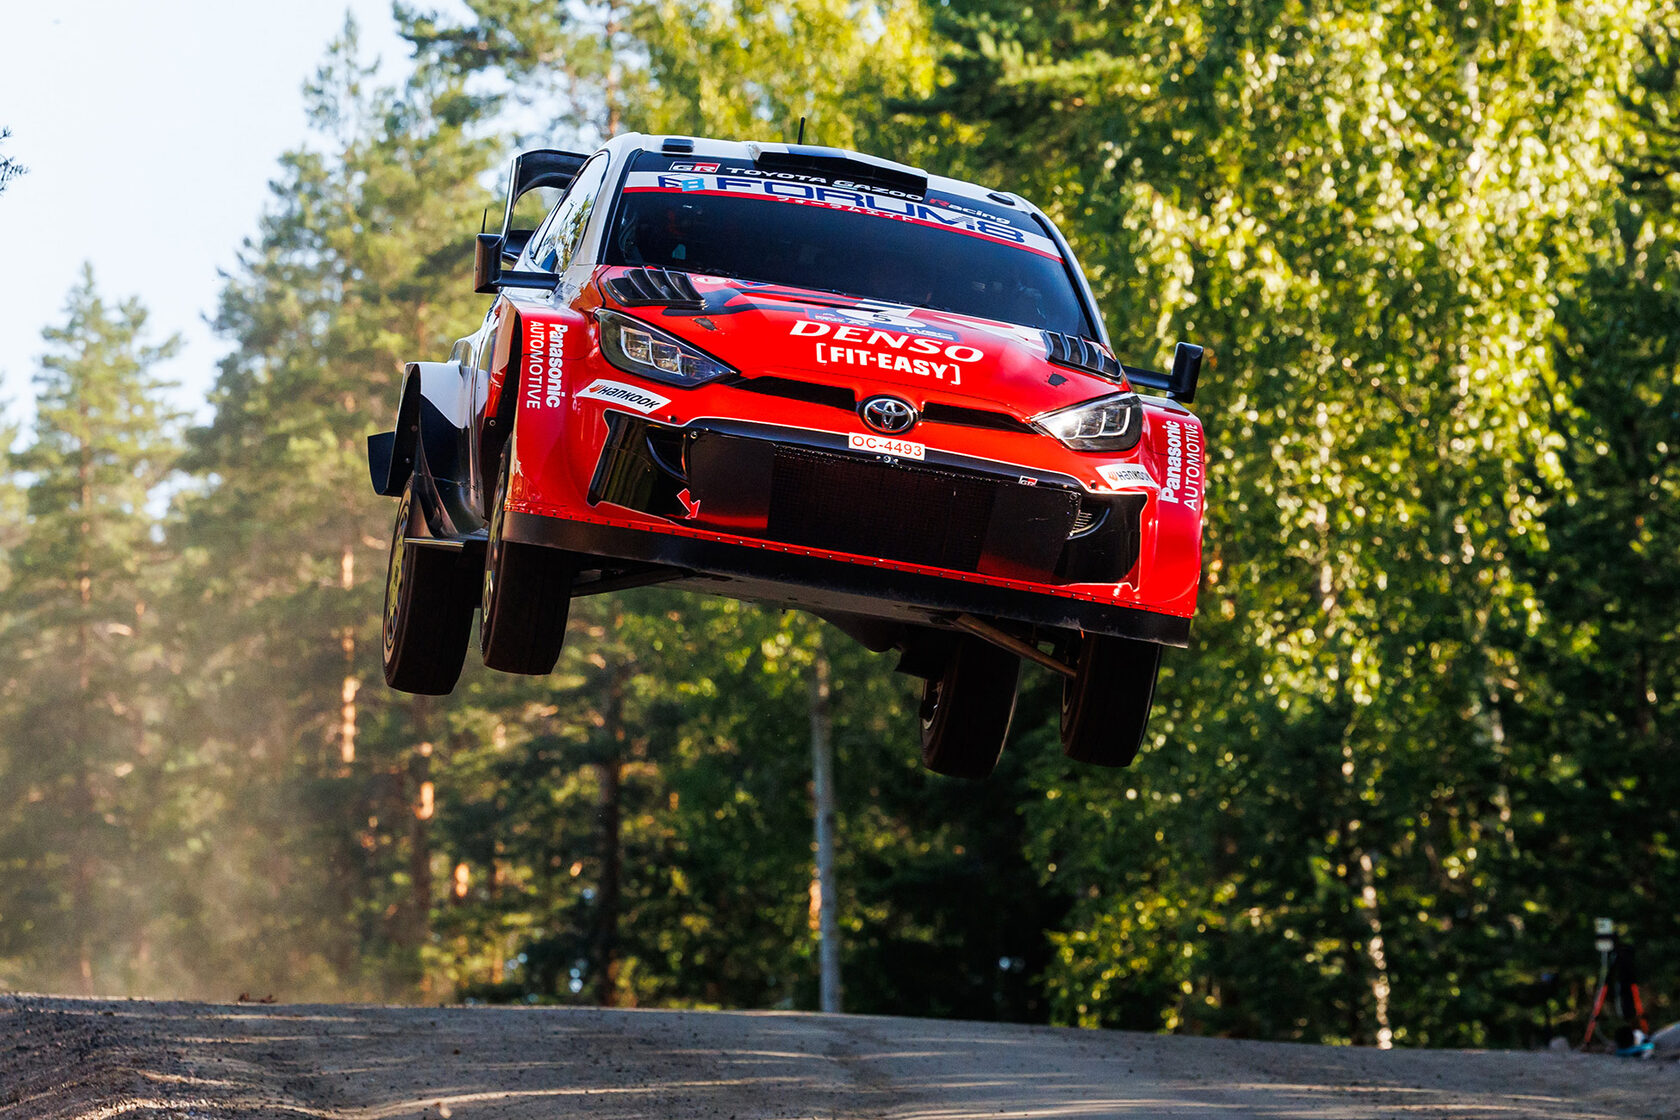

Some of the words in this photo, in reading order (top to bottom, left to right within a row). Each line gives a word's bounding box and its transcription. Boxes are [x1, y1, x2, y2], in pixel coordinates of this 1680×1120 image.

[670, 162, 718, 173] GR
[726, 167, 827, 184] TOYOTA
[832, 179, 924, 202] GAZOO
[929, 198, 1011, 225] Racing
[716, 176, 1025, 243] FORUM8
[526, 320, 545, 410] AUTOMOTIVE
[545, 323, 569, 408] Panasonic
[789, 319, 984, 363] DENSO
[851, 435, 923, 458] OC-4493
[1160, 420, 1181, 504] Panasonic
[1183, 422, 1198, 511] AUTOMOTIVE
